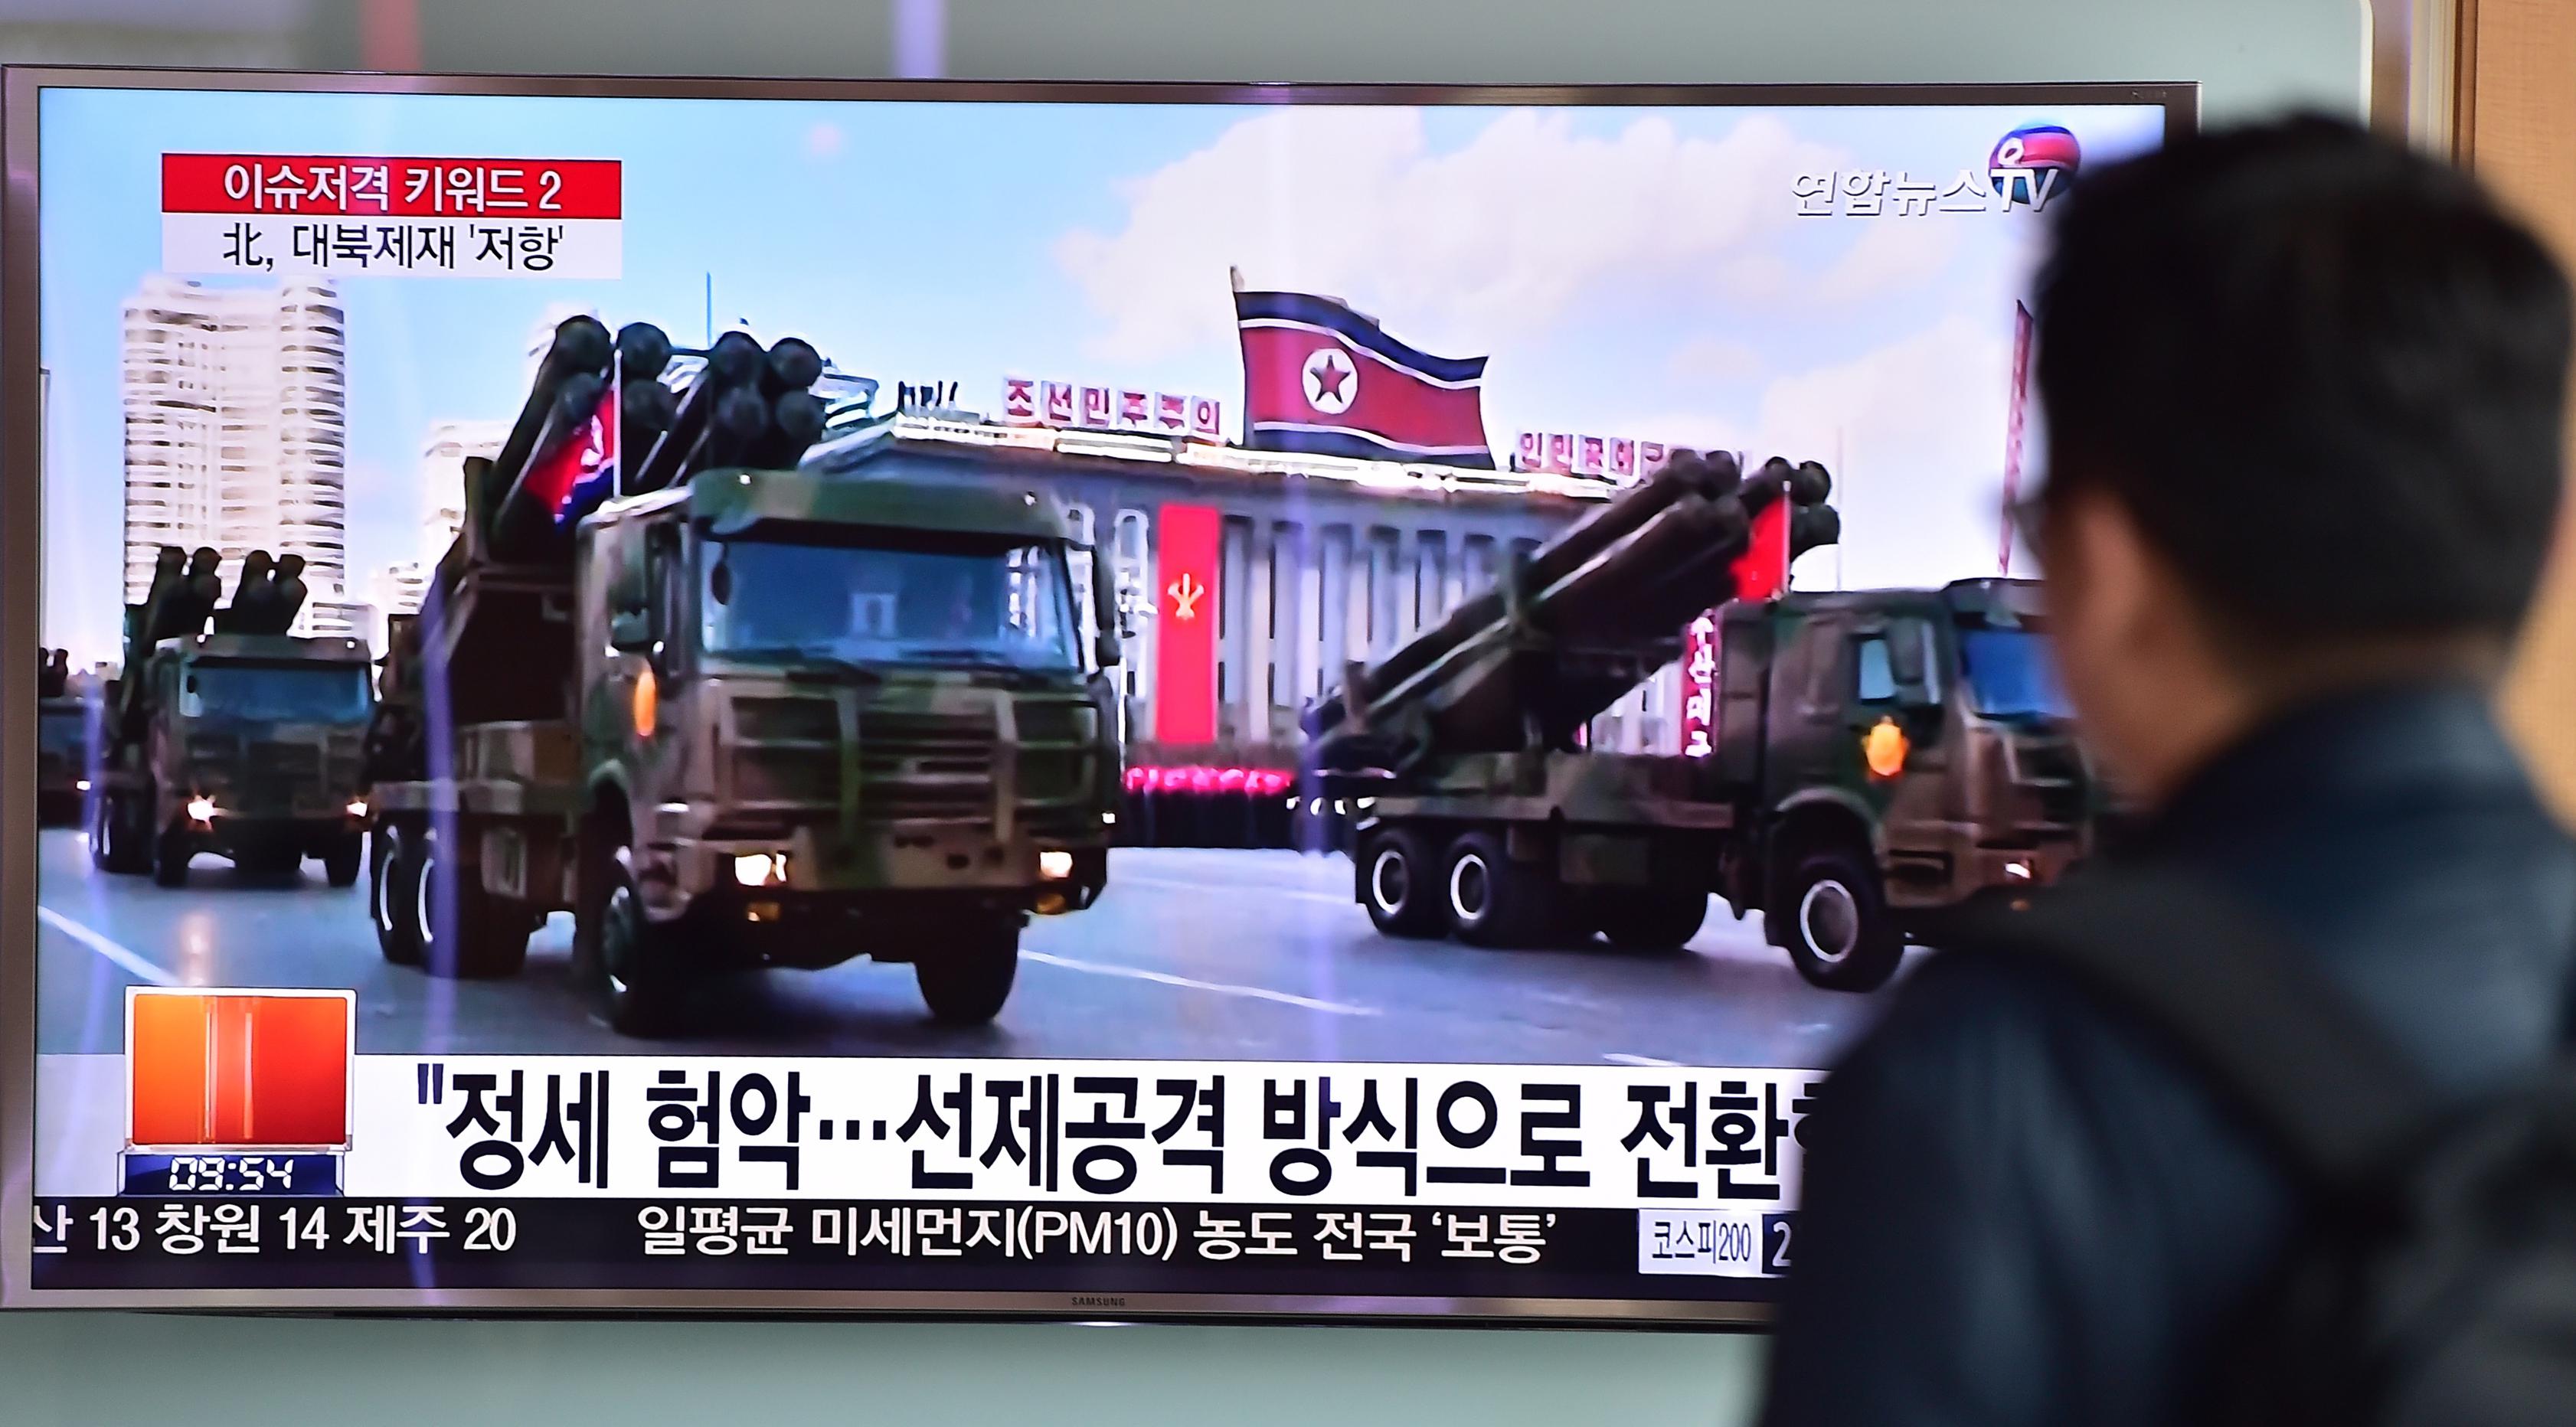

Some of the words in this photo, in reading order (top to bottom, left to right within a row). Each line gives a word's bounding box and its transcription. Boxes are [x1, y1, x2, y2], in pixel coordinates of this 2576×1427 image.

[224, 163, 388, 211] 이슈저격
[404, 166, 528, 212] 키워드
[539, 170, 562, 210] 2
[223, 222, 274, 272] 北,
[293, 224, 455, 269] 대북제재
[469, 223, 564, 271] '저항'
[417, 1063, 610, 1190] "정세
[1263, 1076, 1591, 1197] 방식으로
[169, 1156, 294, 1191] 09:54
[33, 1204, 74, 1253] 산
[89, 1207, 140, 1251] 13
[155, 1203, 260, 1255] 창원
[279, 1206, 330, 1250] 14
[342, 1204, 450, 1255] 제주
[463, 1207, 517, 1252] 20
[637, 1206, 794, 1256] 일평균
[812, 1205, 1178, 1261] 미세먼지(PM10)
[1193, 1210, 1298, 1261] 농도
[1313, 1212, 1417, 1262] 전국
[1652, 1220, 1752, 1264] 코스피200
[1071, 1297, 1126, 1306] SAMSUNG
